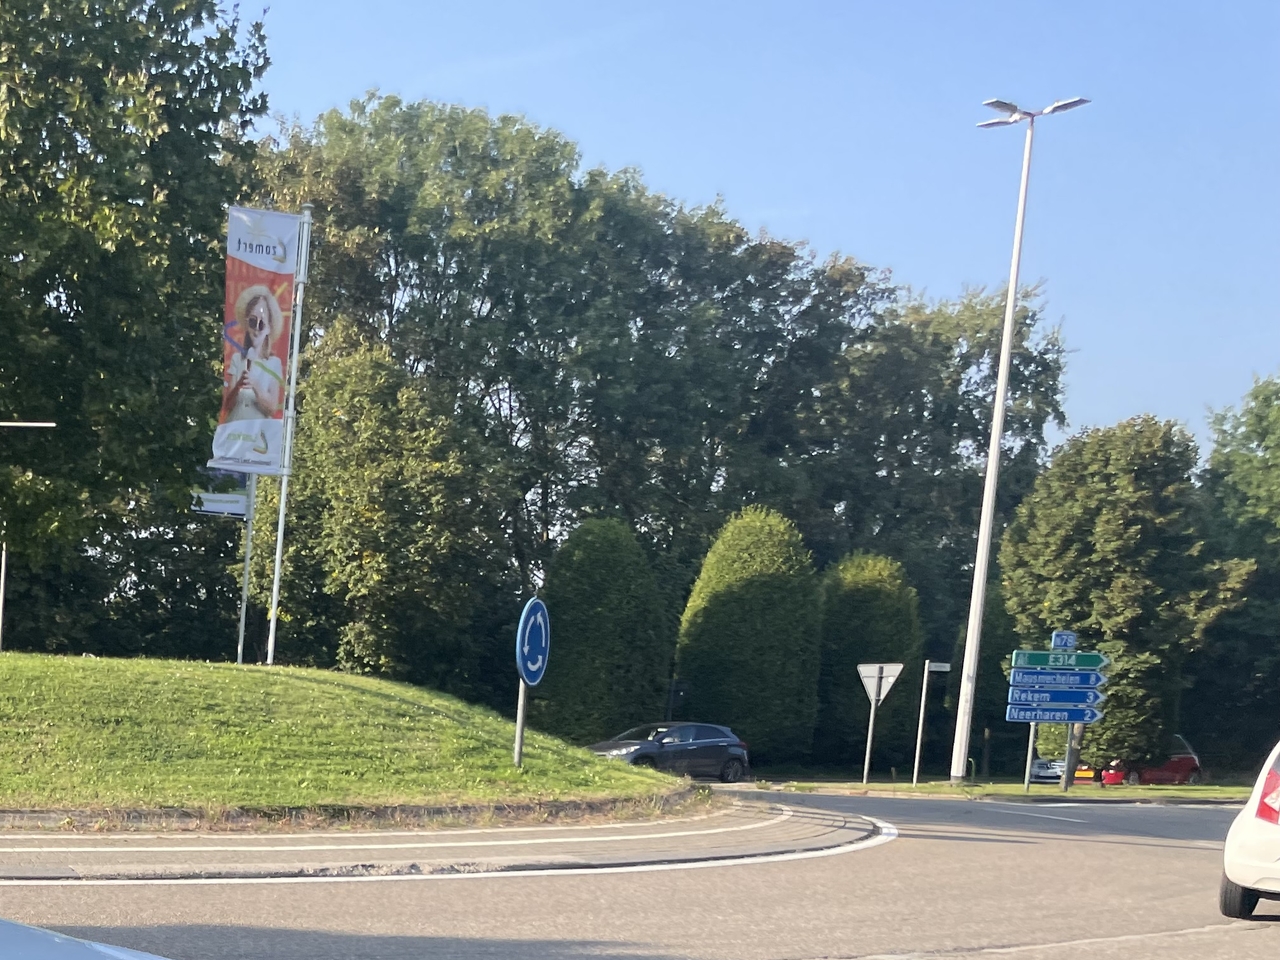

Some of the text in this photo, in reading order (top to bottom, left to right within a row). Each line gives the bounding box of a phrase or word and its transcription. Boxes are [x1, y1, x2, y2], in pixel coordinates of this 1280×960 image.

[1049, 655, 1077, 666] E314
[1089, 673, 1096, 684] 8
[1012, 692, 1094, 703] Rekem 3
[1010, 709, 1091, 721] Neerharen 2
